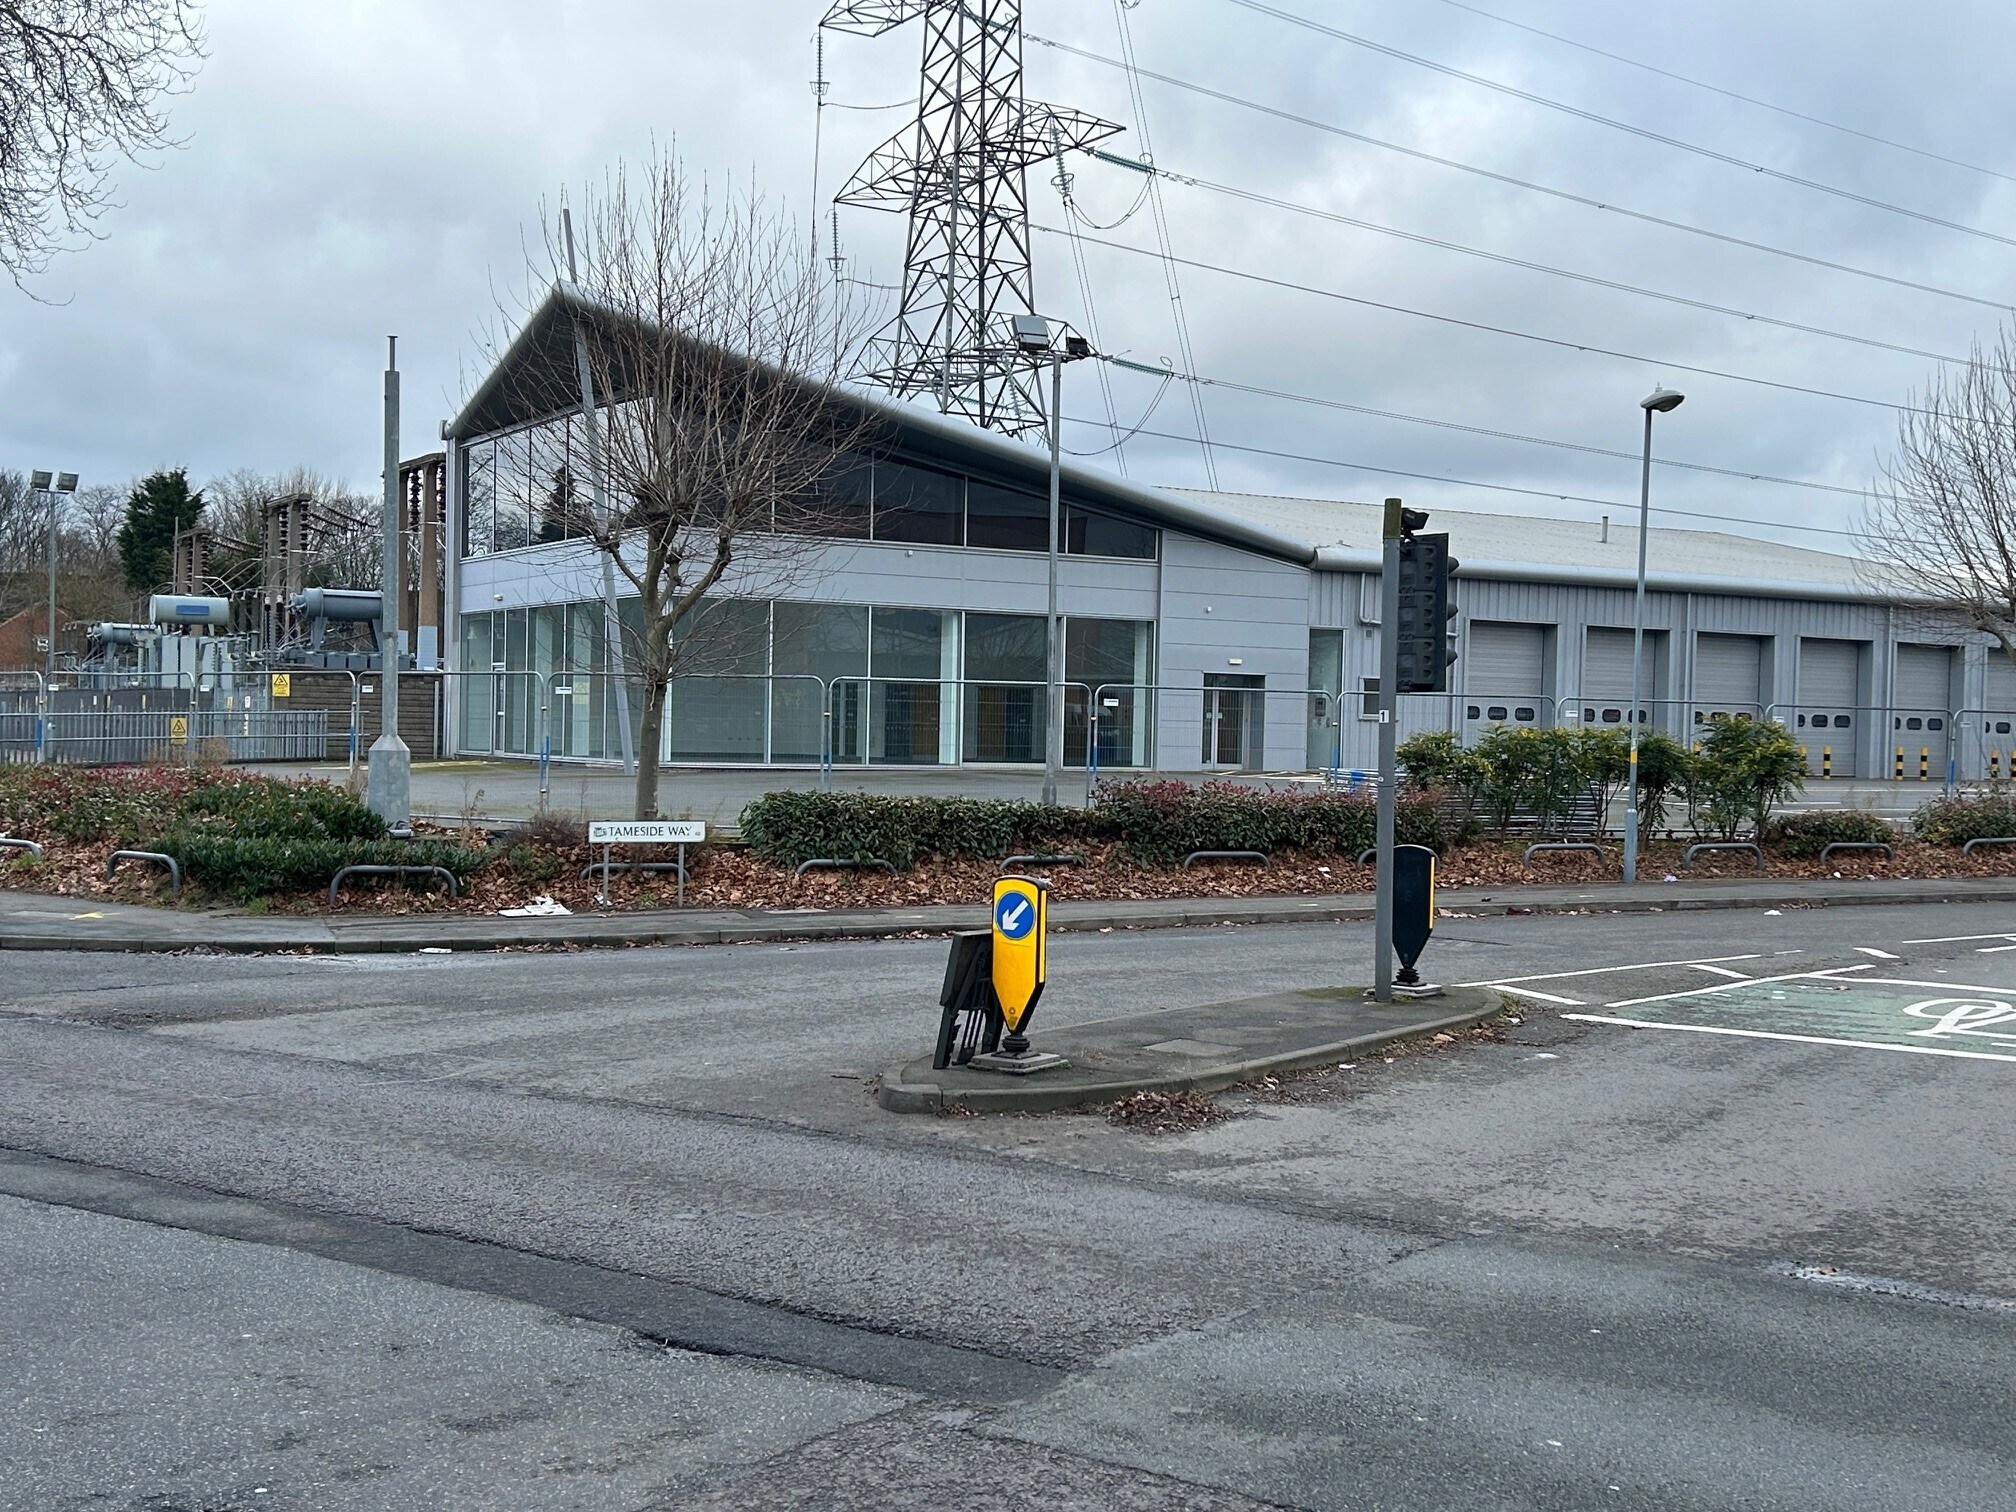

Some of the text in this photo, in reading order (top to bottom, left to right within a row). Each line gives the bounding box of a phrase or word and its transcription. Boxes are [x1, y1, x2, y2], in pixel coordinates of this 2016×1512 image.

[1381, 711, 1385, 722] 1
[609, 826, 664, 837] TAMESIDE
[668, 826, 692, 836] WAY
